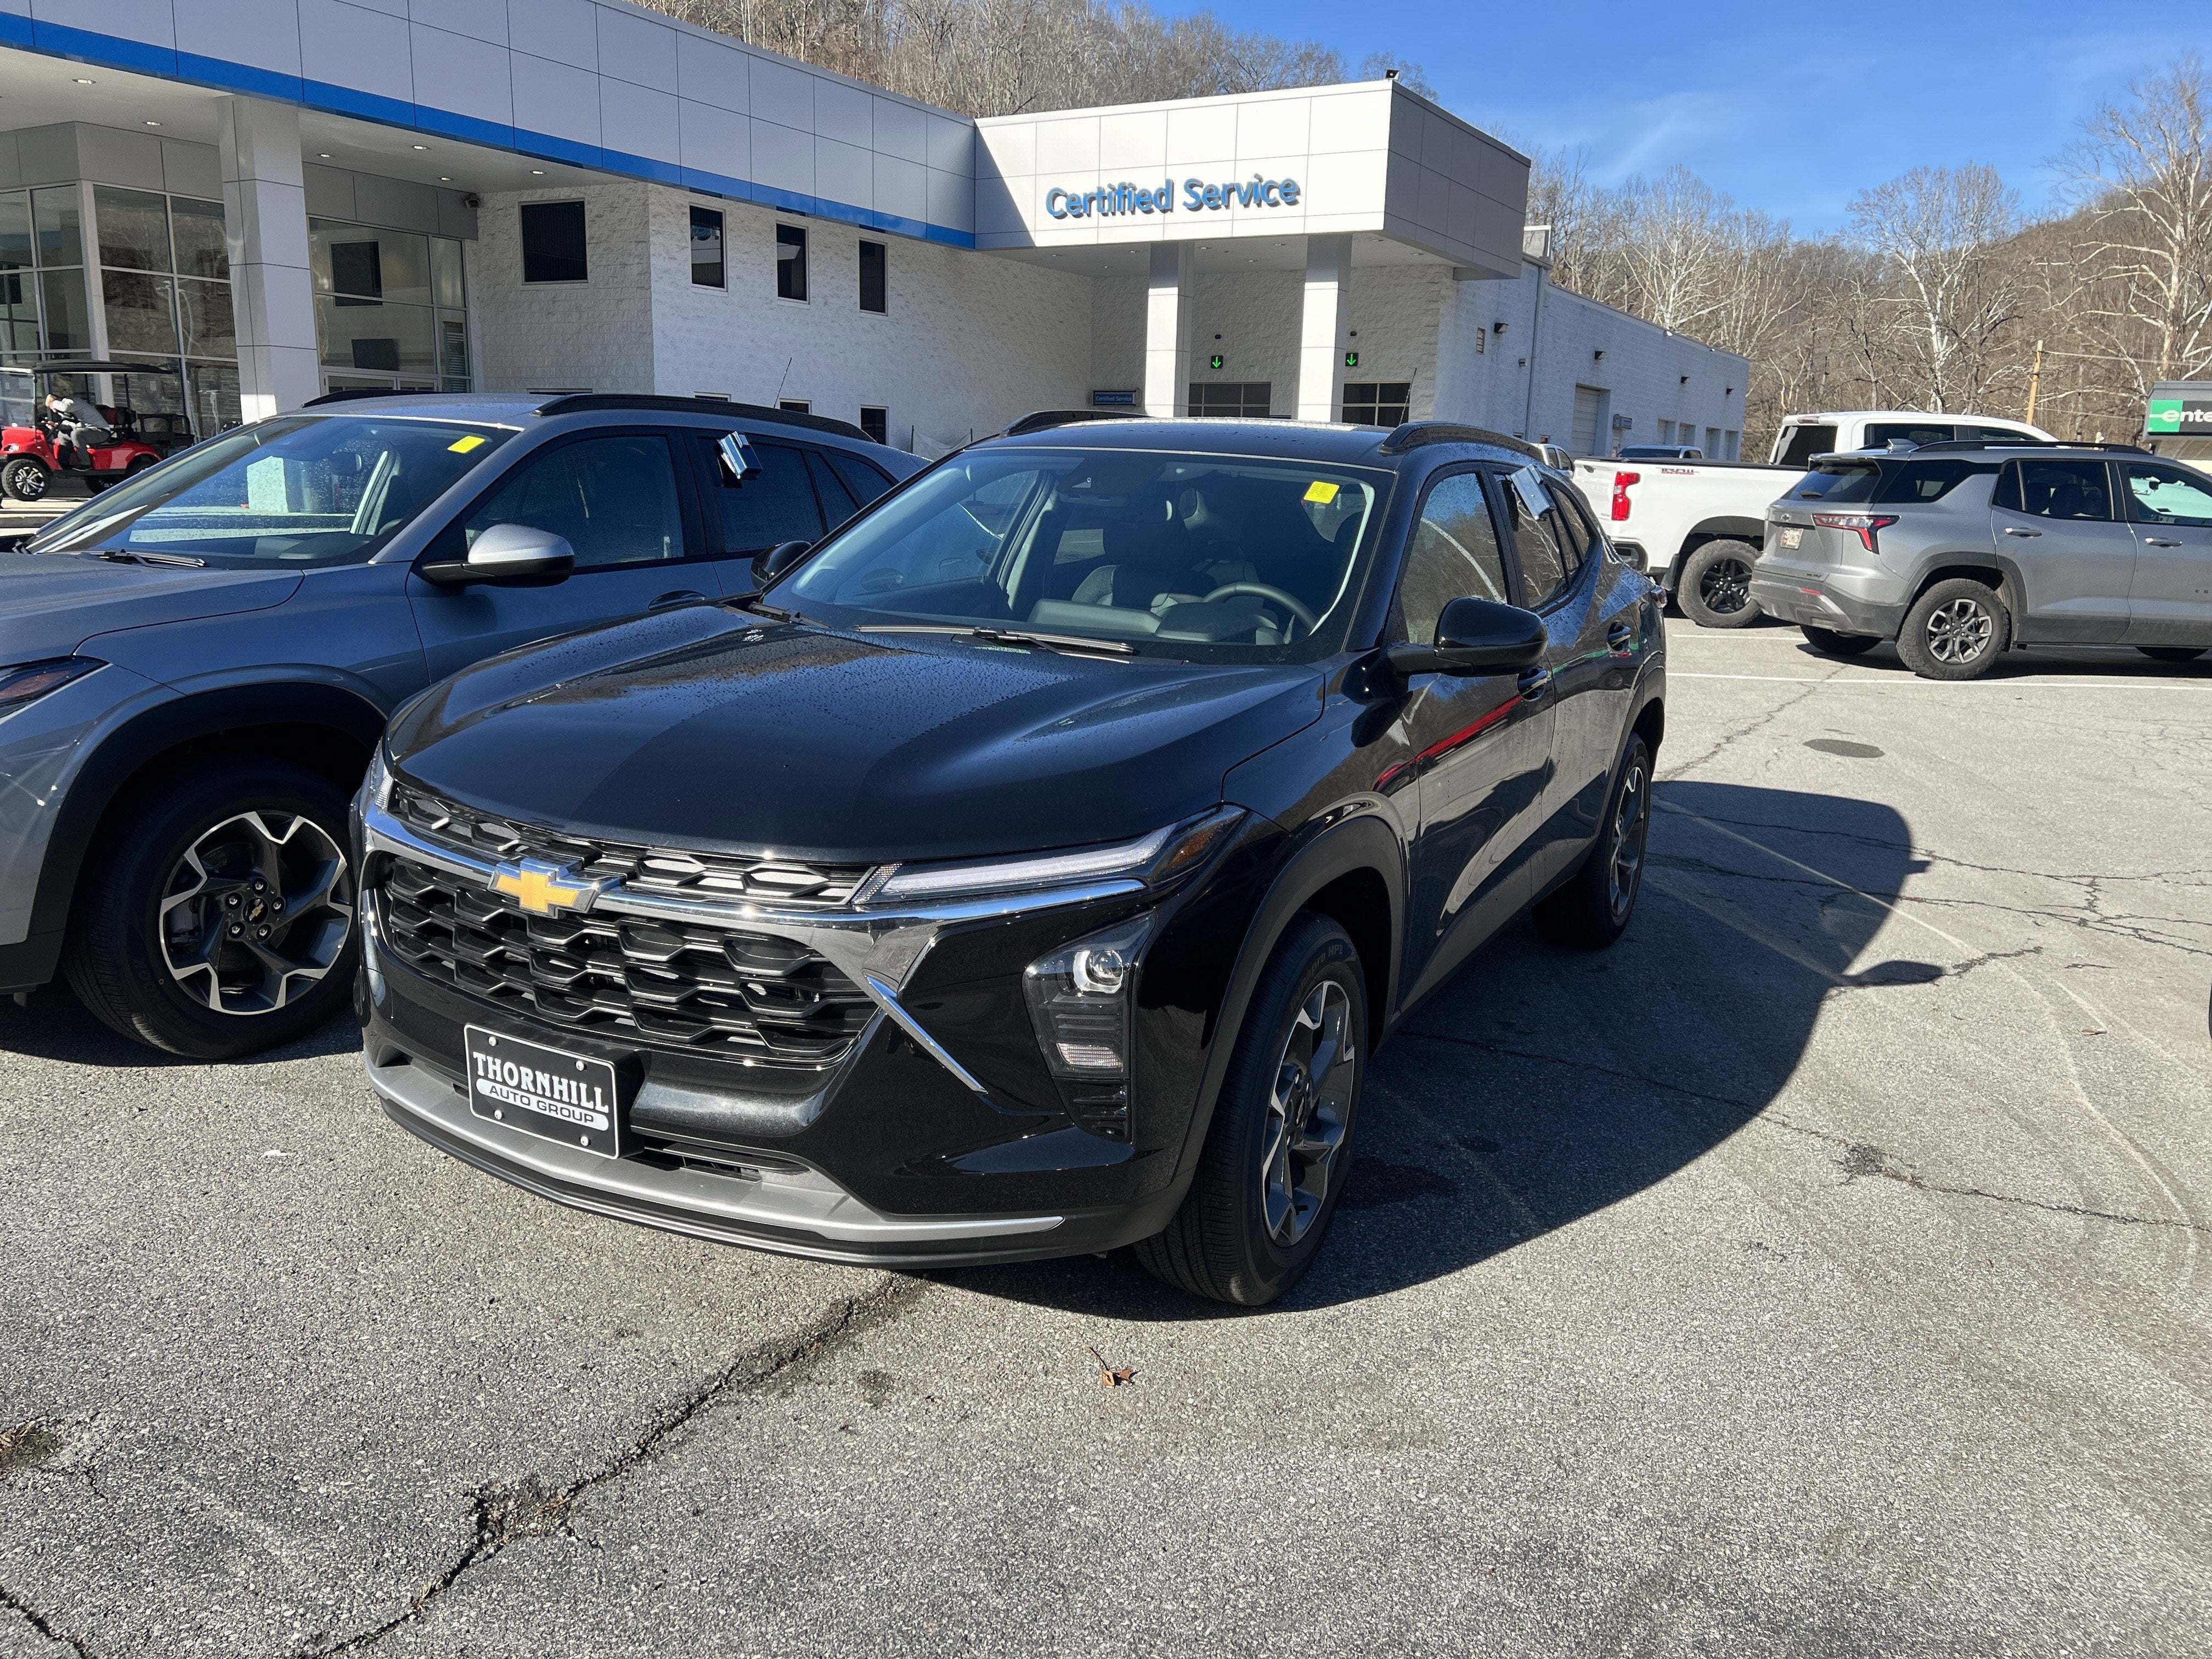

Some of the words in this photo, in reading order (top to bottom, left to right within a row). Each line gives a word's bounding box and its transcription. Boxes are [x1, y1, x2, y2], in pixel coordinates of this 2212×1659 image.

[1046, 178, 1173, 219] Certified
[1183, 173, 1300, 211] Service
[472, 1051, 609, 1113] THORNHILL
[489, 1085, 531, 1107] AUTO
[537, 1099, 594, 1124] GROUP
